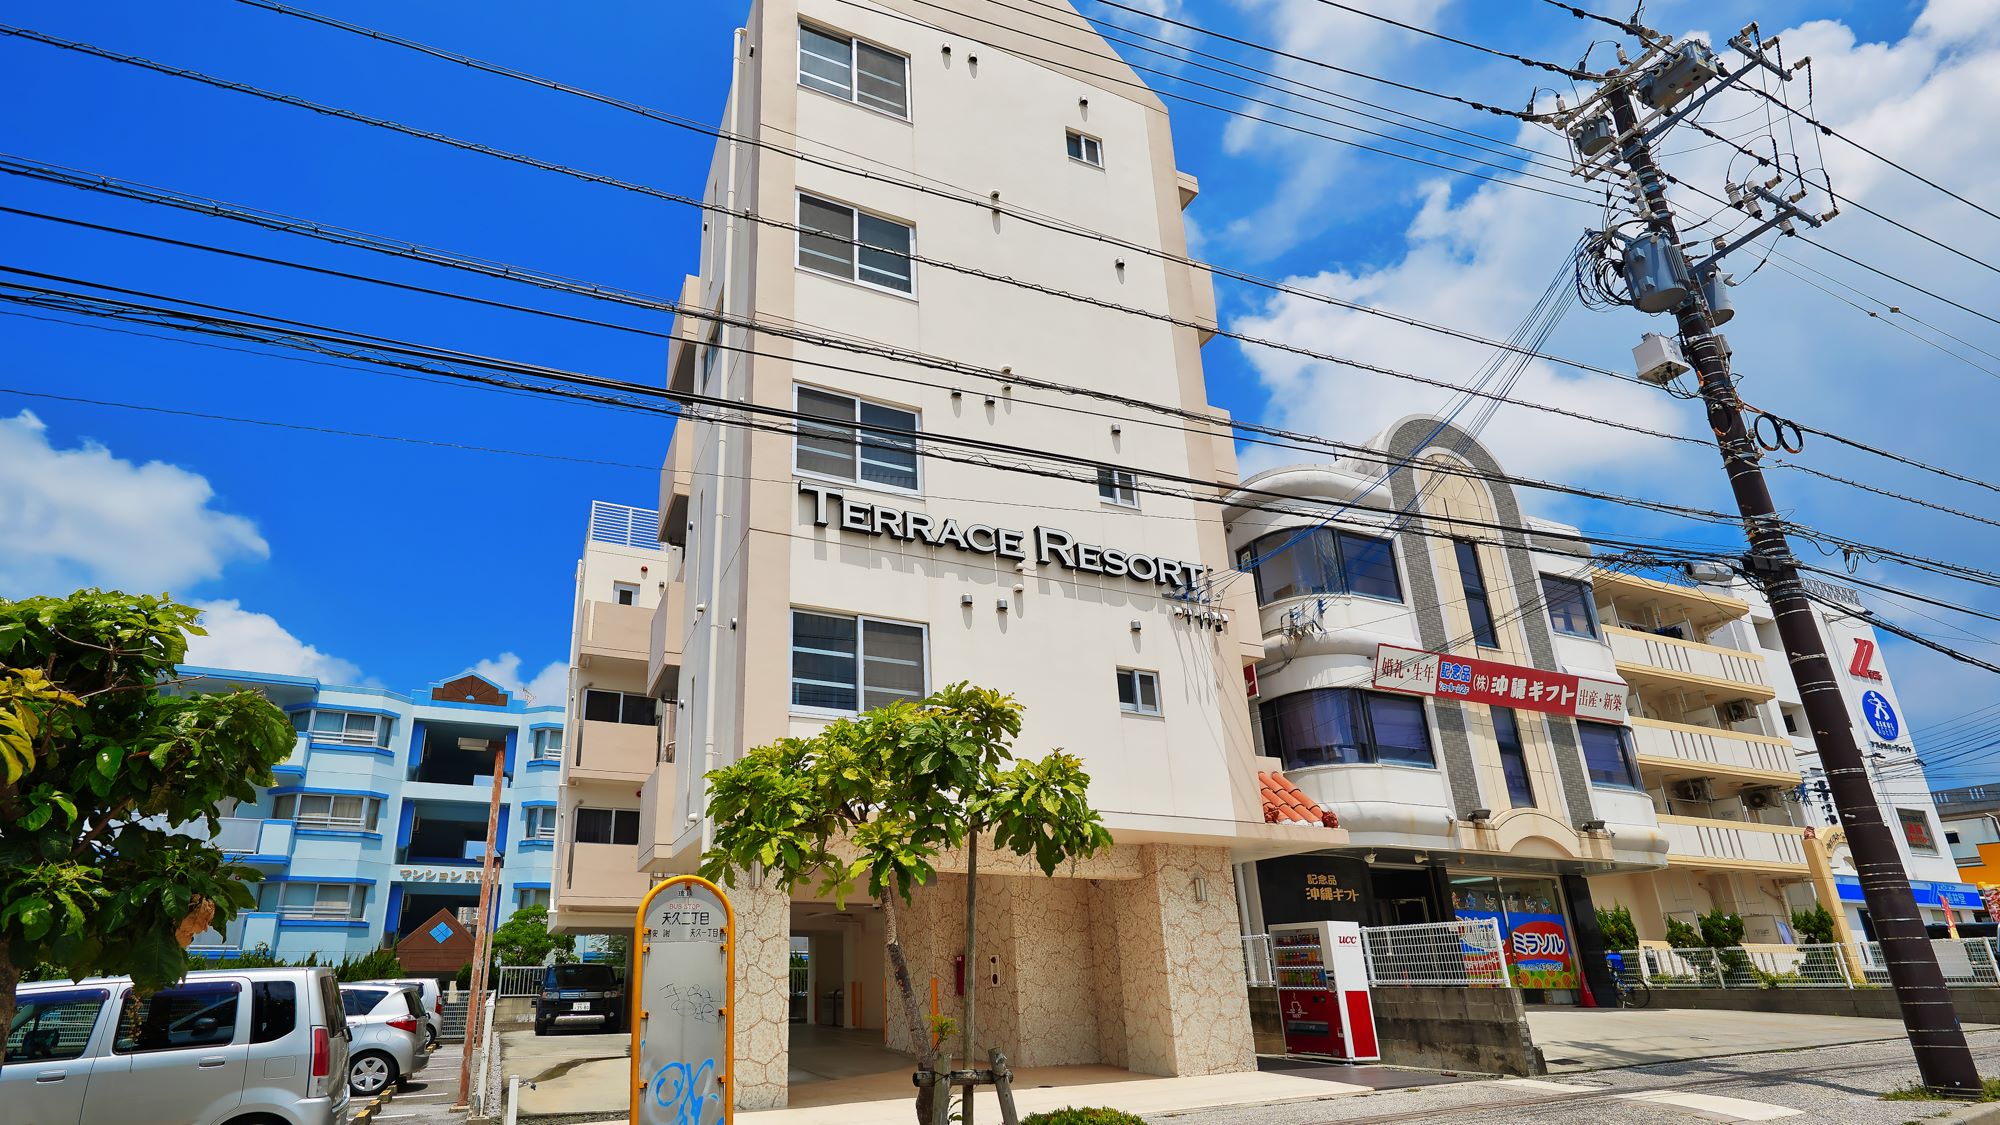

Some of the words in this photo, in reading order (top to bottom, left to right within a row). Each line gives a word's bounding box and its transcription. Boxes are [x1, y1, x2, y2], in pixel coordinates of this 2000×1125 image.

[798, 480, 1026, 563] TERRACE
[1034, 525, 1205, 593] RESORT
[1440, 661, 1472, 682] 記念品
[1578, 688, 1624, 712] 出産・新築
[400, 869, 463, 882] マンション
[1306, 873, 1338, 886] 記念品
[1305, 886, 1360, 903] 沖縄ギフト
[661, 911, 710, 926] 天久二丁目
[689, 928, 719, 938] 天久一丁目
[1512, 931, 1565, 955] ミラソル
